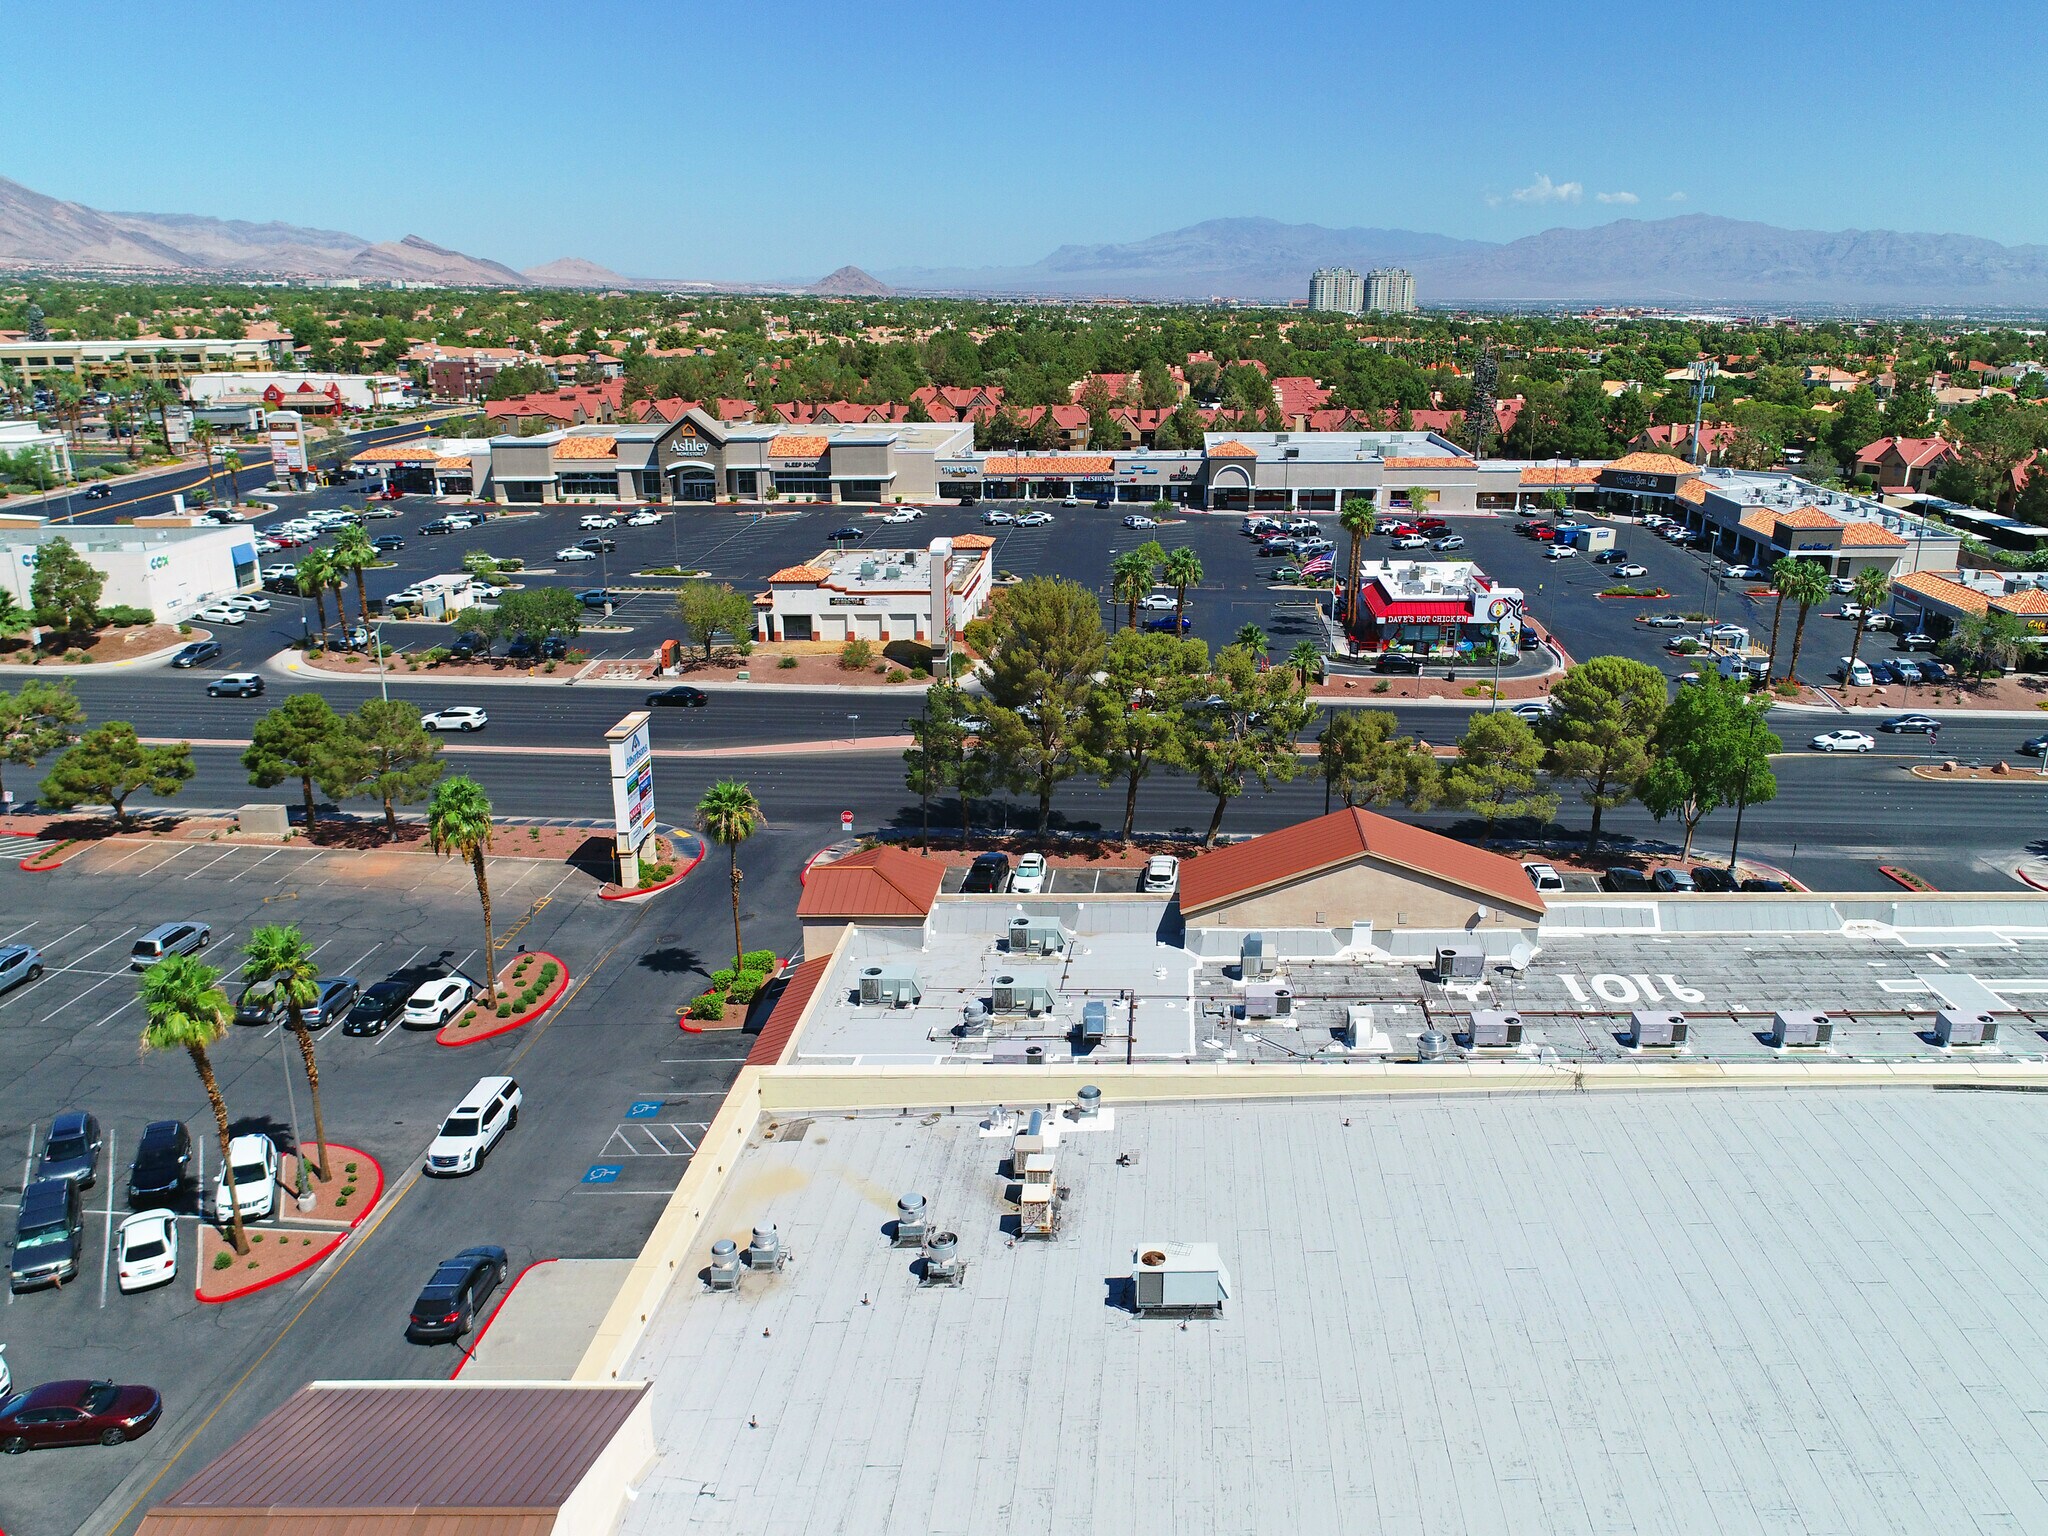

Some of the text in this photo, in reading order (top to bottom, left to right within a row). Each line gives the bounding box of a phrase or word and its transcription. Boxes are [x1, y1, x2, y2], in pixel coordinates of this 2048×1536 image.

[670, 438, 709, 454] Ashley
[1388, 615, 1468, 623] DAVE'S HOT CHICKEN
[626, 744, 648, 769] Albertsons
